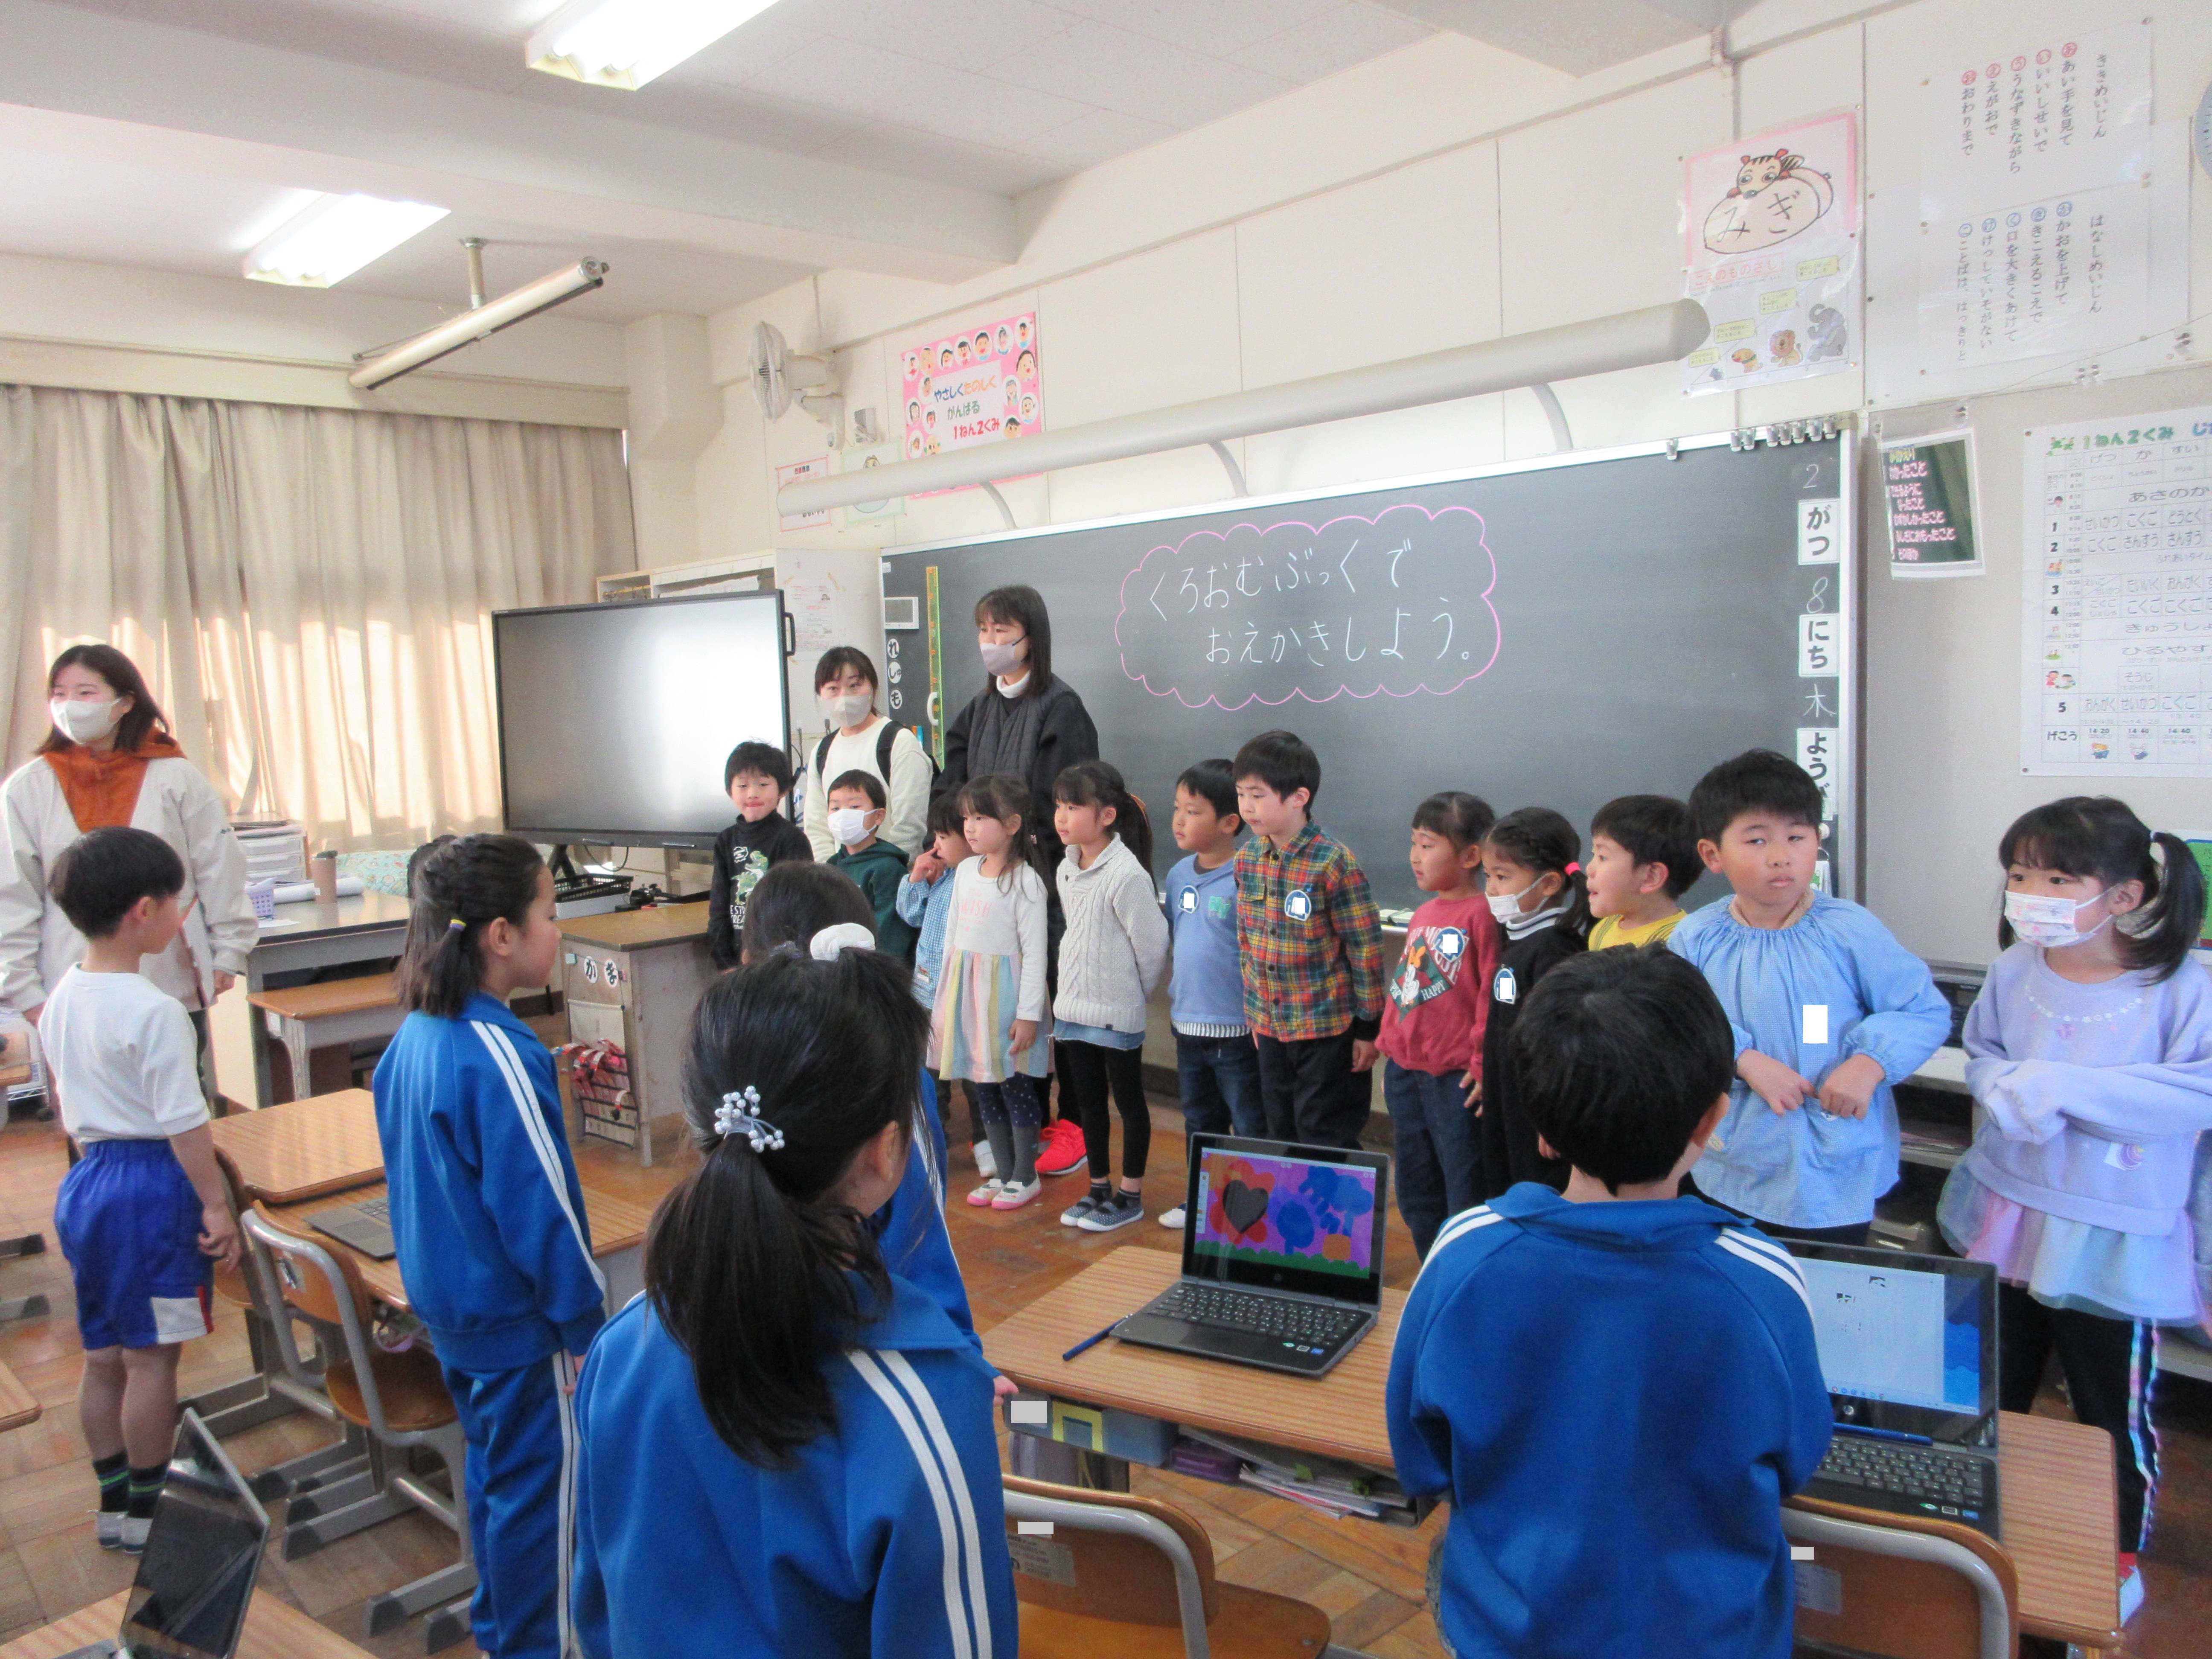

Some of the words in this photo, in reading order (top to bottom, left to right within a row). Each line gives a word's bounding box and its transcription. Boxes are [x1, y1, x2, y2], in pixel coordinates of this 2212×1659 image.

[2059, 61, 2075, 146] あい手を見て
[2094, 54, 2108, 139] ききめいじん
[1961, 87, 1975, 156] おわりまで
[1694, 260, 1778, 287] こえのものさし
[2089, 215, 2104, 314] はなしめいじん
[948, 400, 980, 420] がんばる
[954, 418, 1000, 439] 1ねん2くみ
[2083, 426, 2174, 449] 1ねん2くみ
[1803, 464, 1819, 489] 2
[1807, 504, 1831, 556] がつ
[2052, 522, 2058, 532] 1
[2050, 542, 2058, 552] 2
[2088, 537, 2117, 552] こくご
[1807, 577, 1828, 613] 8
[2051, 585, 2059, 595] 3
[2051, 606, 2059, 616] 4
[2128, 599, 2161, 614] こくご
[2165, 598, 2201, 613] こくご
[889, 641, 899, 656] れ
[1807, 621, 1829, 669] にち
[889, 667, 902, 680] しゅ
[891, 691, 901, 707] も
[1803, 684, 1836, 718] 木
[2058, 702, 2066, 713] 5
[2161, 695, 2197, 710] こくご
[2047, 731, 2078, 741] げこう
[1807, 733, 1830, 798] よう
[586, 959, 597, 980] か
[1421, 980, 1446, 1001] HAPPY
